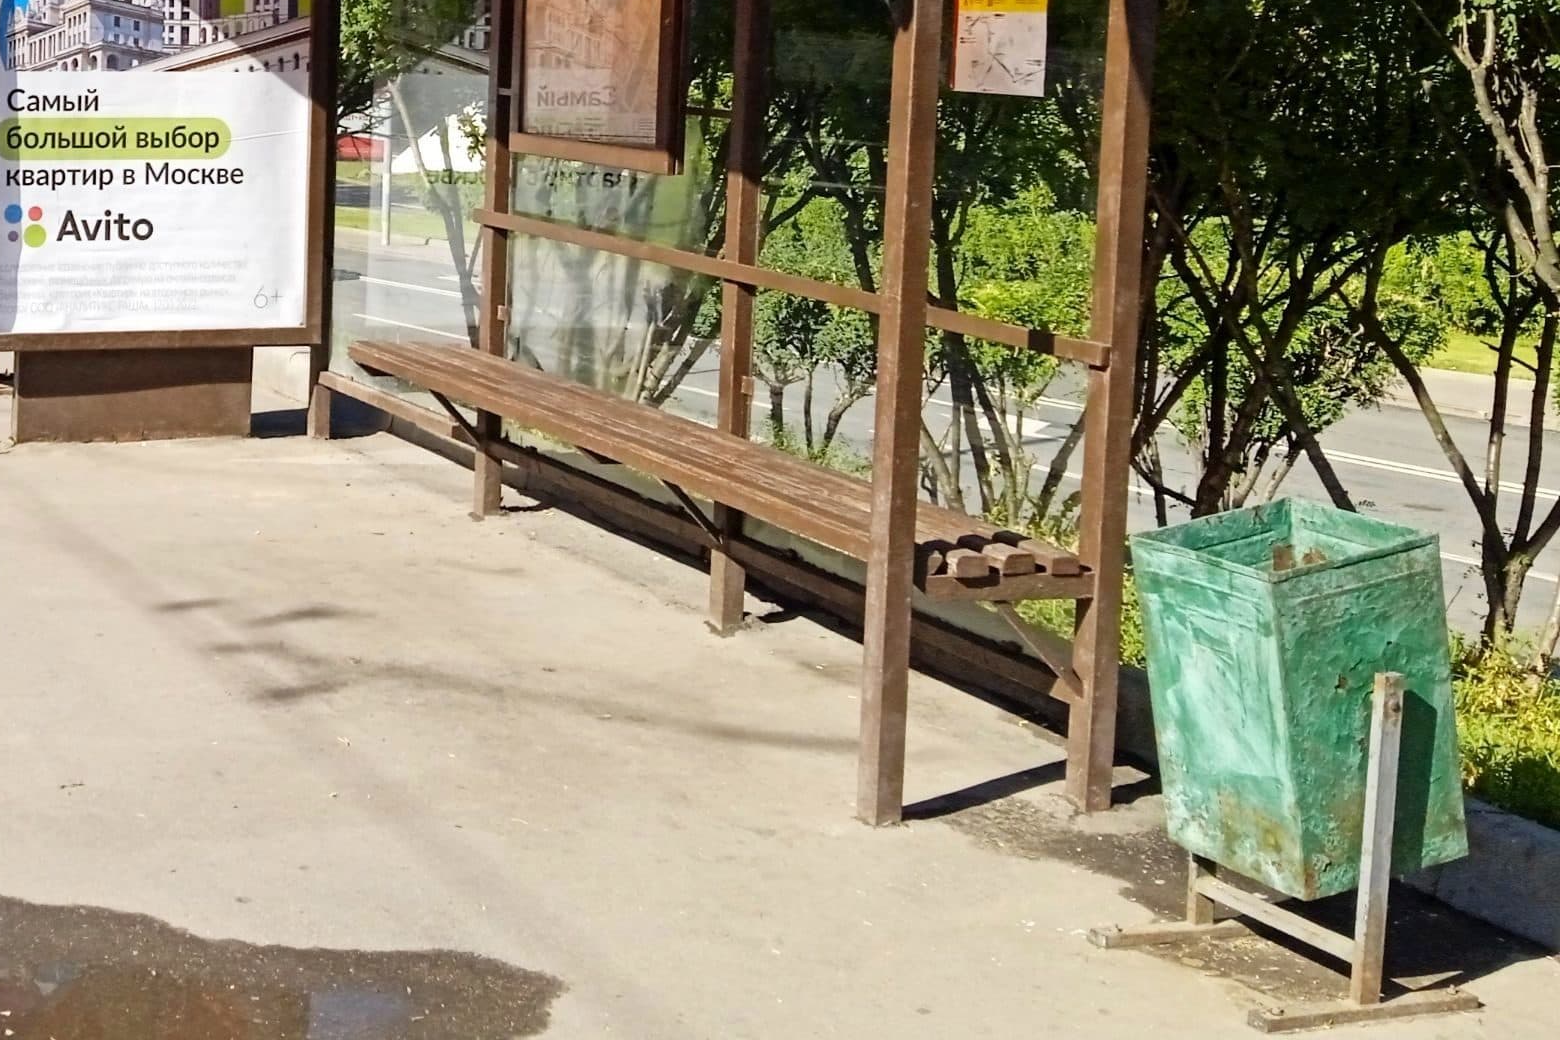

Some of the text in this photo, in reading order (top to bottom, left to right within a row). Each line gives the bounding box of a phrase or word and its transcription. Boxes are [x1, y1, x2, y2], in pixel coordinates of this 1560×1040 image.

[7, 88, 99, 112] Самый
[6, 125, 220, 153] большой выбор
[5, 162, 245, 190] квартир в Москве
[56, 209, 154, 242] Avito
[253, 285, 284, 310] 6+
